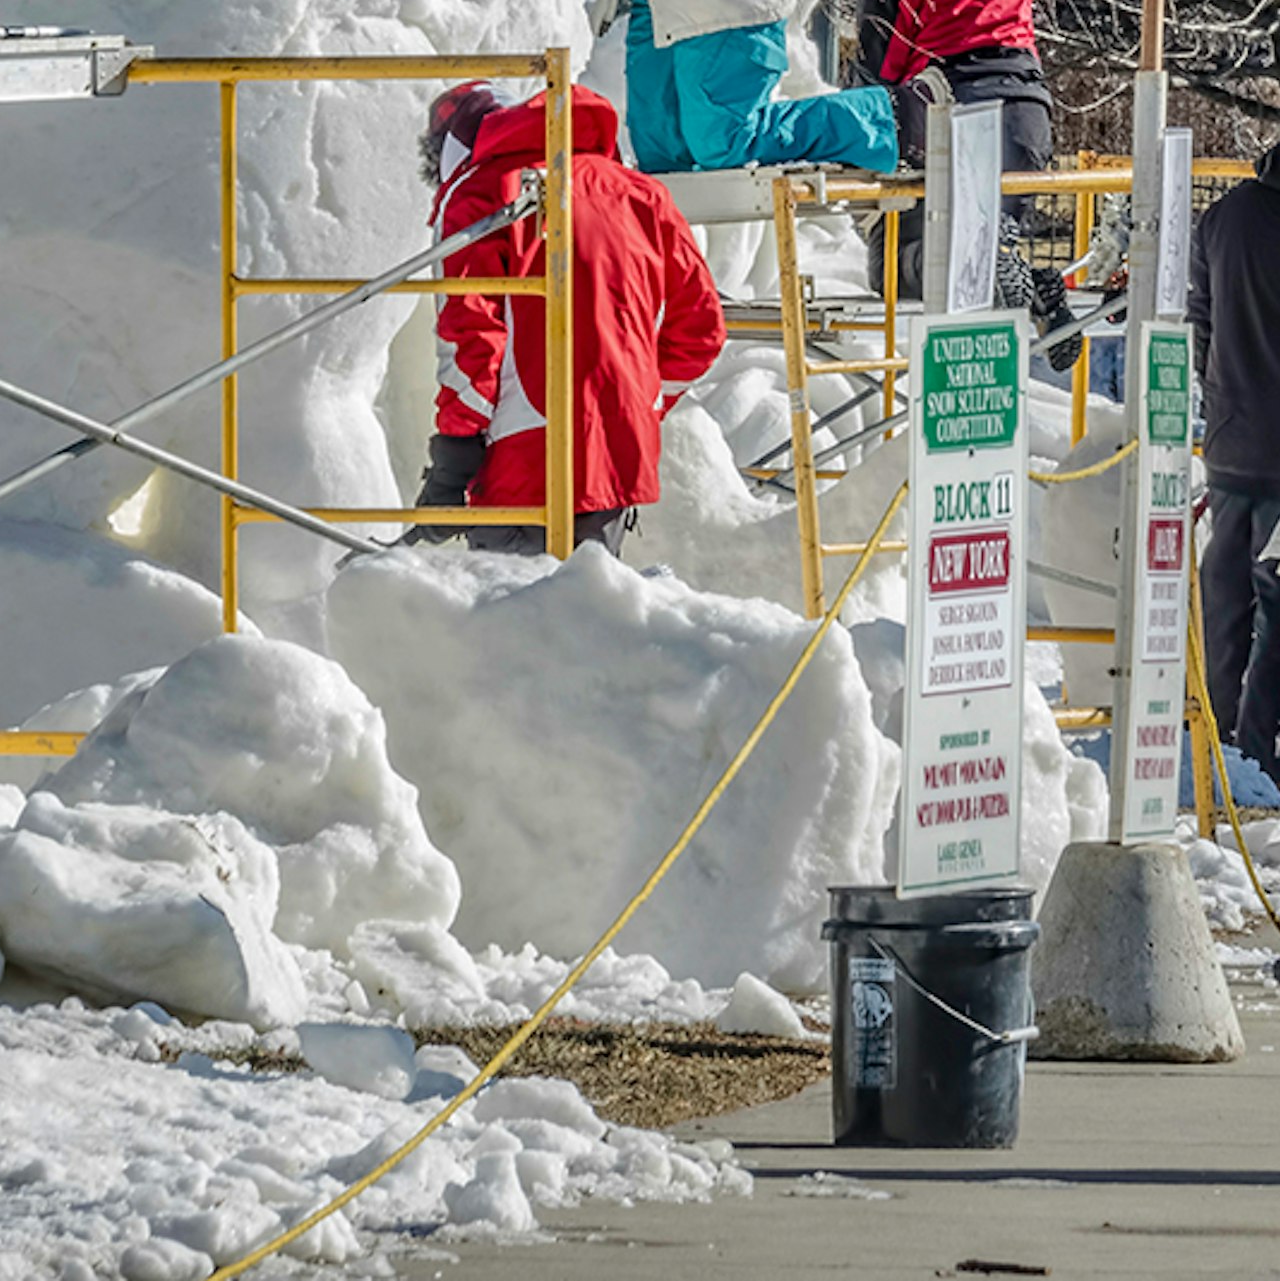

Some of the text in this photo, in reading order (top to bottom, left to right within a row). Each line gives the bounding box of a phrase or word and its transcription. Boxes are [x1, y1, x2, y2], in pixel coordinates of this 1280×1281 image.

[933, 332, 1011, 363] UNITED STATES
[946, 361, 997, 388] NATIONAL
[927, 385, 1014, 417] SNOW SCULPTING
[936, 412, 1005, 442] COMPETITION
[933, 477, 1011, 523] BLOCK 11
[932, 539, 1007, 584] NEW YORK
